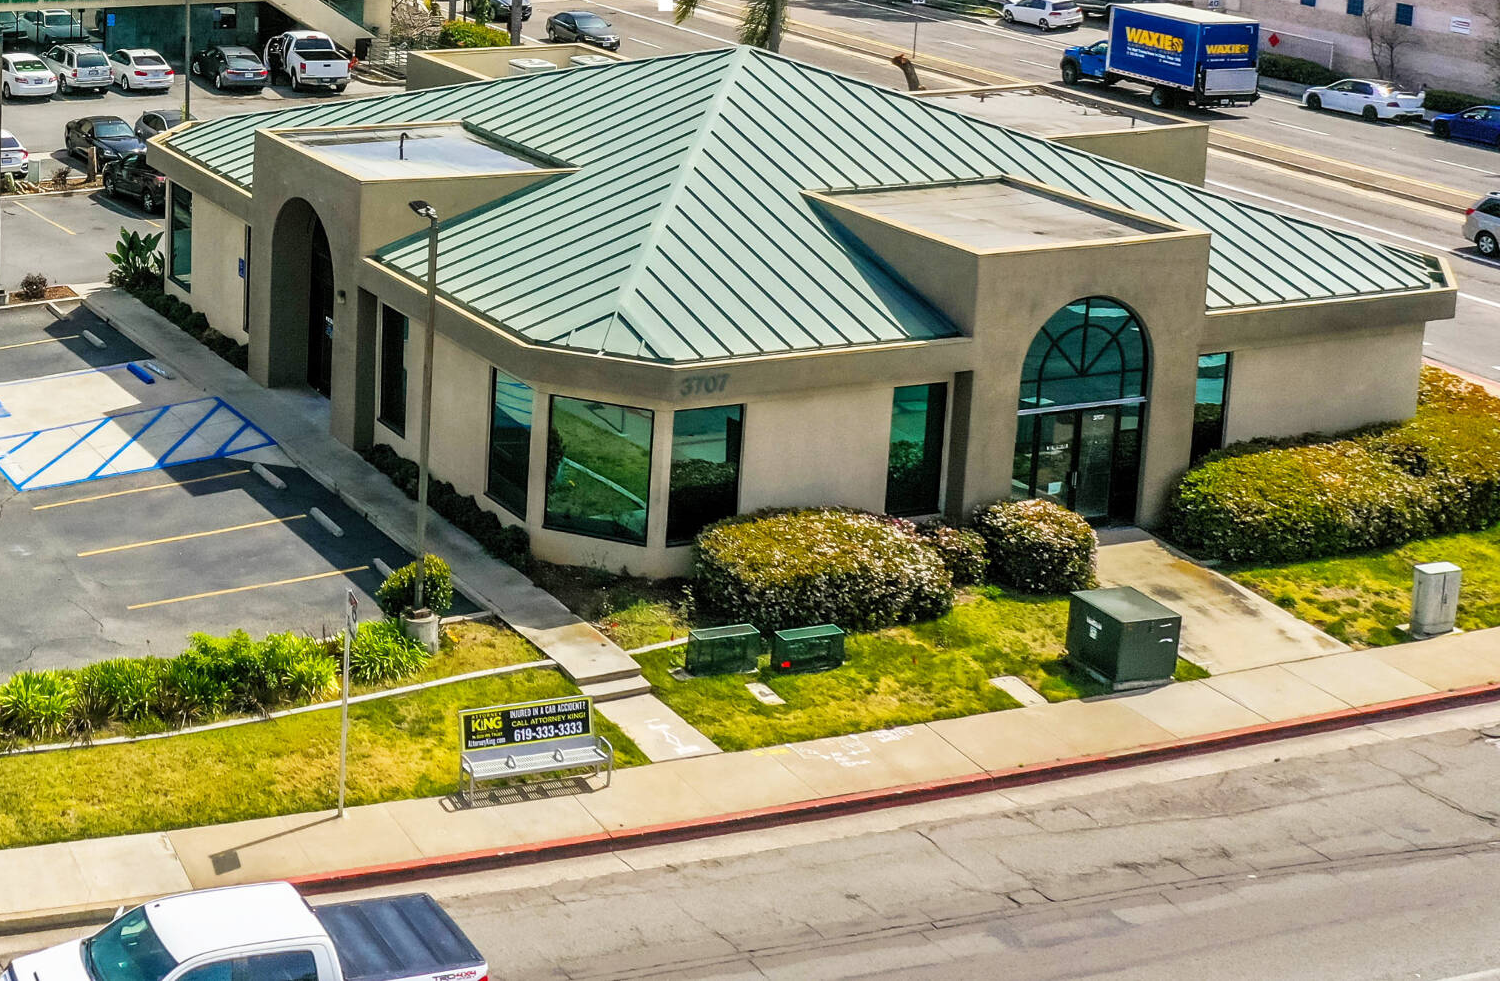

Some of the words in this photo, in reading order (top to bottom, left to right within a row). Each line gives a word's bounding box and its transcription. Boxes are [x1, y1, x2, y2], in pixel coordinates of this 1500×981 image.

[680, 373, 731, 396] 3707
[510, 708, 531, 719] INJURED
[532, 707, 539, 716] IN
[540, 706, 544, 715] A
[545, 704, 556, 714] CAR
[557, 701, 586, 712] ACCIDENT?
[530, 715, 566, 725] ATTORNEY
[567, 712, 586, 720] KING!
[471, 716, 503, 732] KING
[514, 721, 583, 742] 619-333-3333
